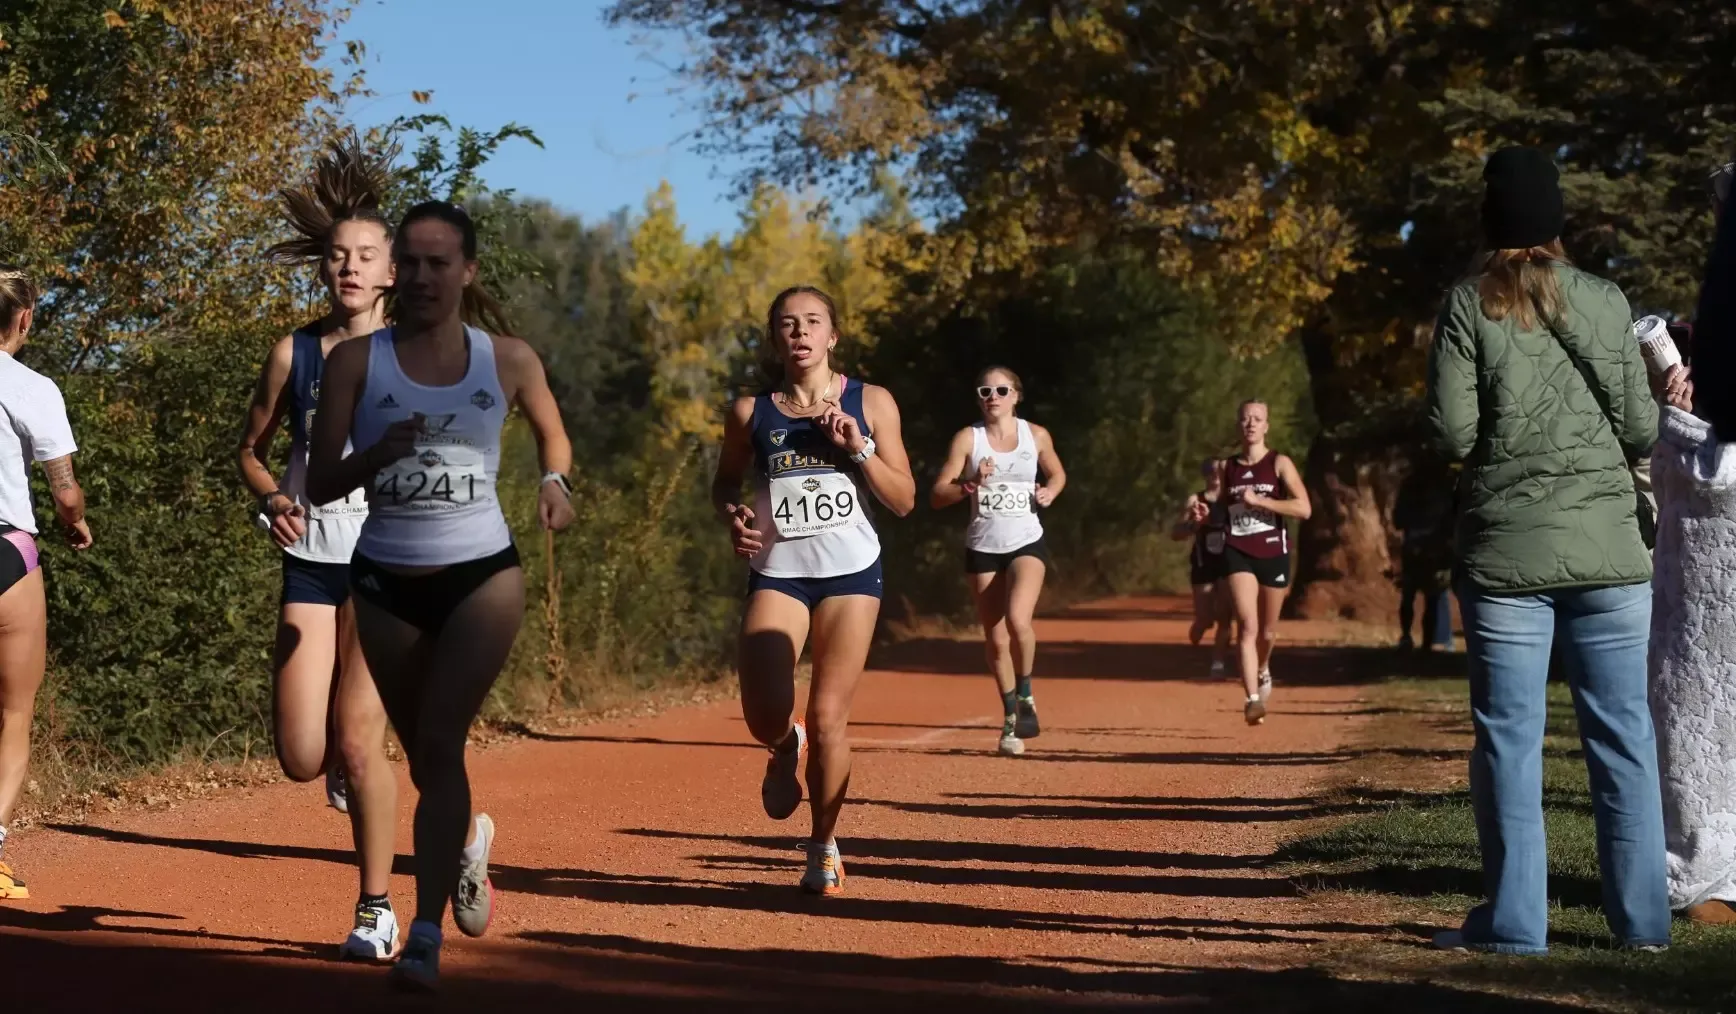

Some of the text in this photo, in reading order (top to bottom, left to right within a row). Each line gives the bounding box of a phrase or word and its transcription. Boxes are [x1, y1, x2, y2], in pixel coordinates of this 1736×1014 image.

[378, 471, 476, 505] 4241
[774, 491, 854, 524] 4169
[980, 493, 1028, 510] 4239
[801, 520, 849, 532] CHAMPIONSHIP
